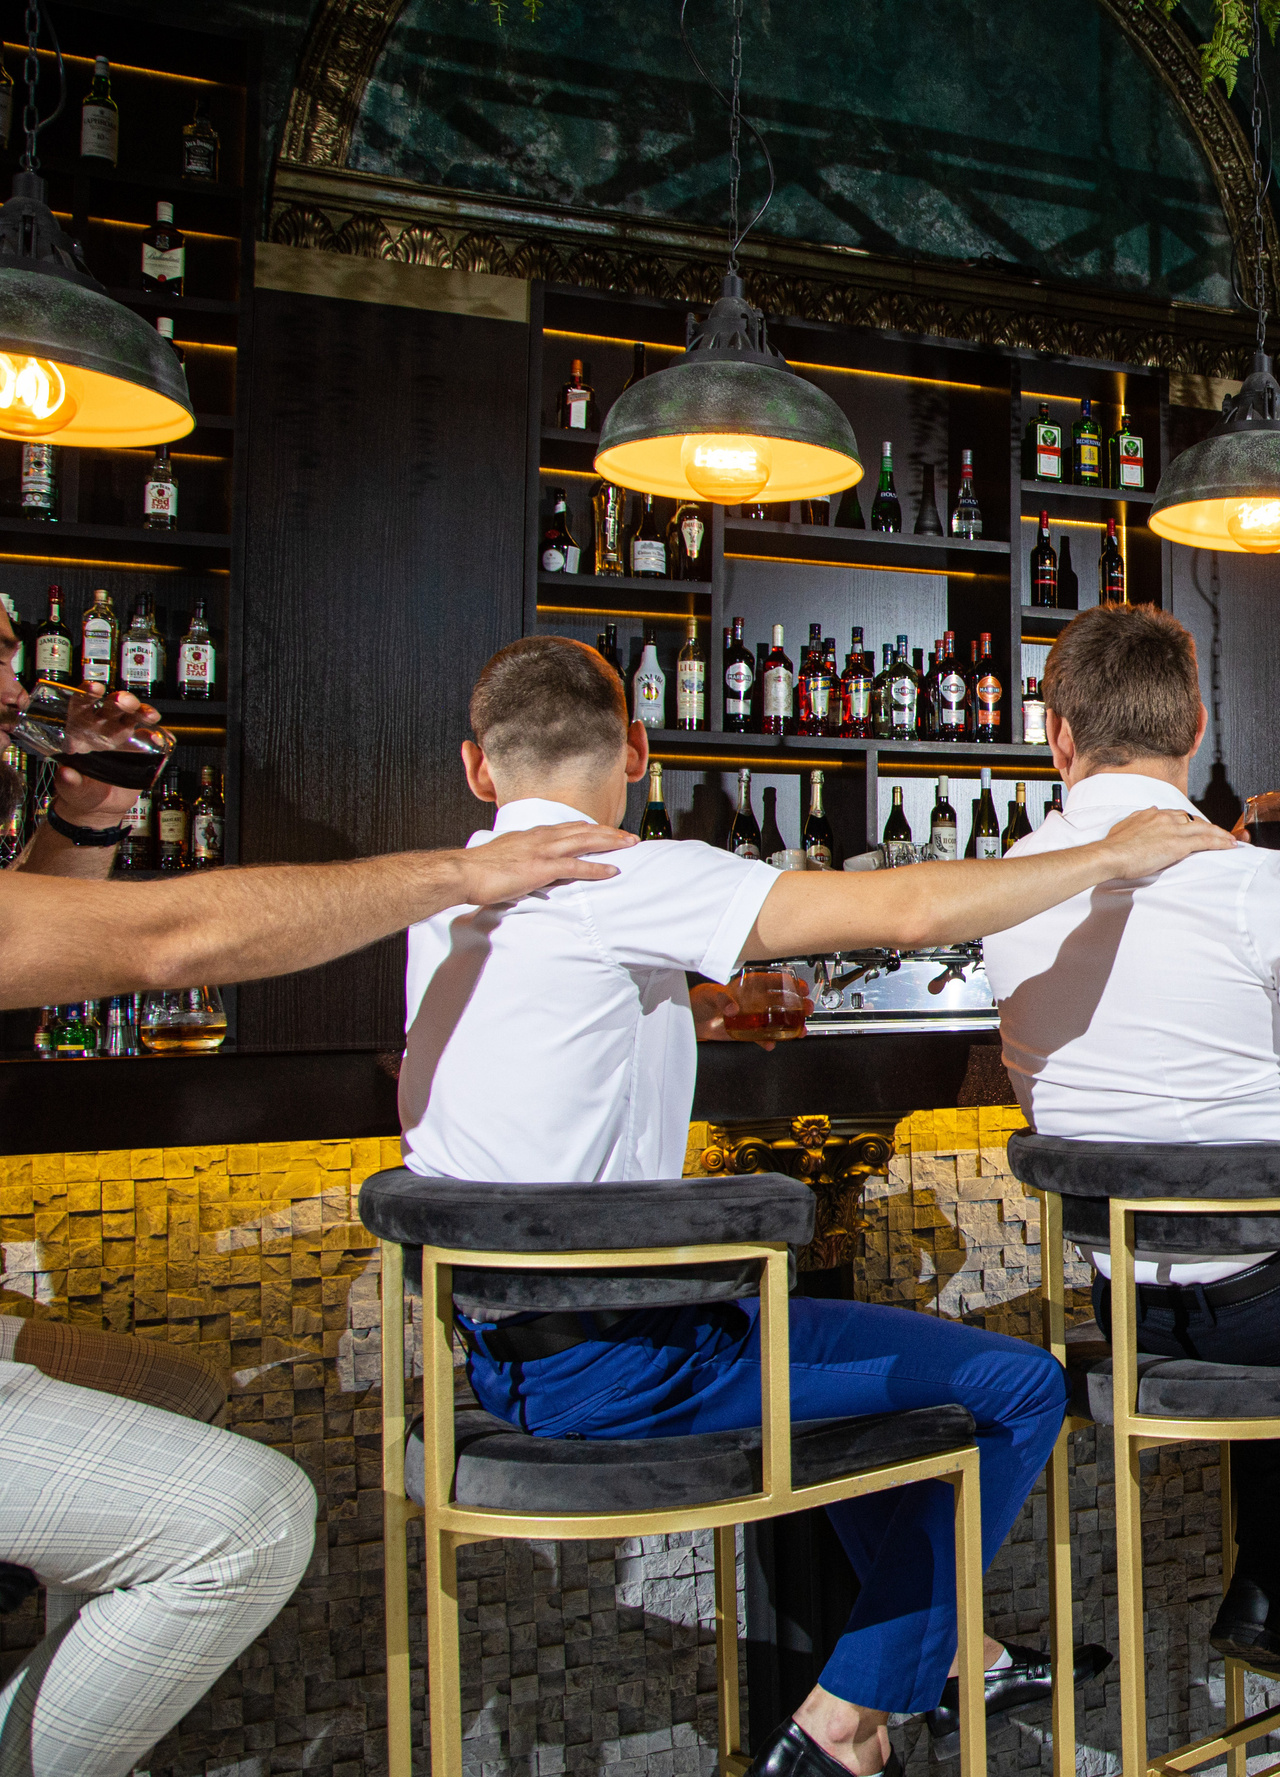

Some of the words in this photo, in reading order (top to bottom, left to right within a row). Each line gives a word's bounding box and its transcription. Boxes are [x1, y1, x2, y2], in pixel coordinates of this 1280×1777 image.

[39, 637, 70, 647] JAMESON
[187, 663, 207, 671] red
[186, 669, 207, 677] STAG
[942, 684, 966, 692] MAINI
